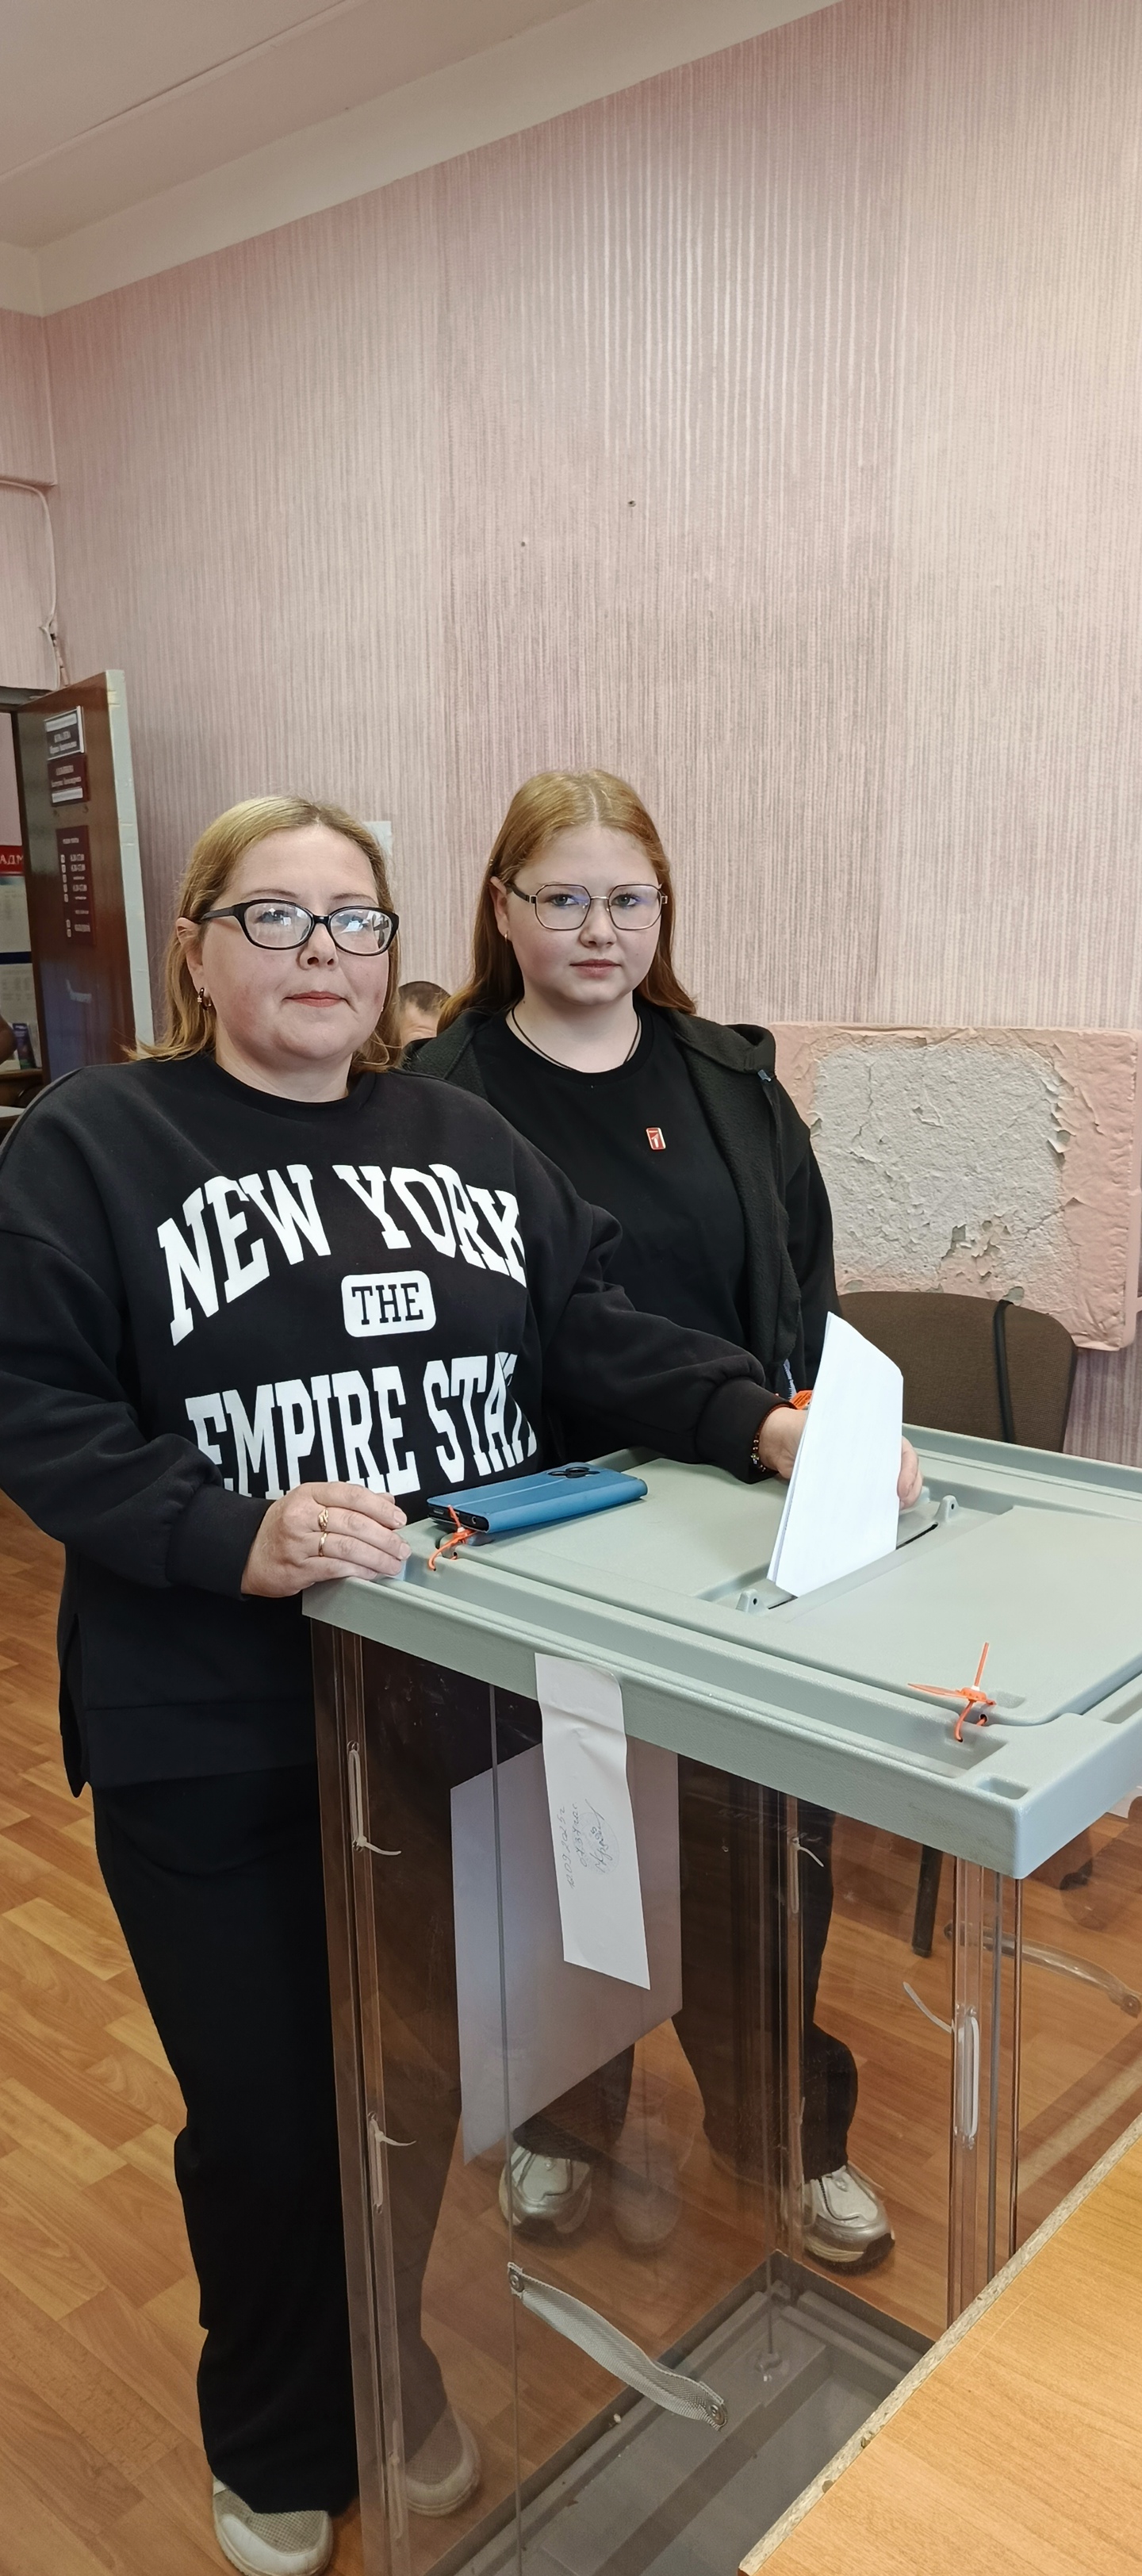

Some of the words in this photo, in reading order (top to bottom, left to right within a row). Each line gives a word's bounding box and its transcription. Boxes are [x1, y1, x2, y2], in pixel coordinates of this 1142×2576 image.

[157, 1163, 331, 1346] NEW
[331, 1163, 527, 1289] YORK
[351, 1282, 424, 1326] THE
[184, 1366, 421, 1501] EMPIRE
